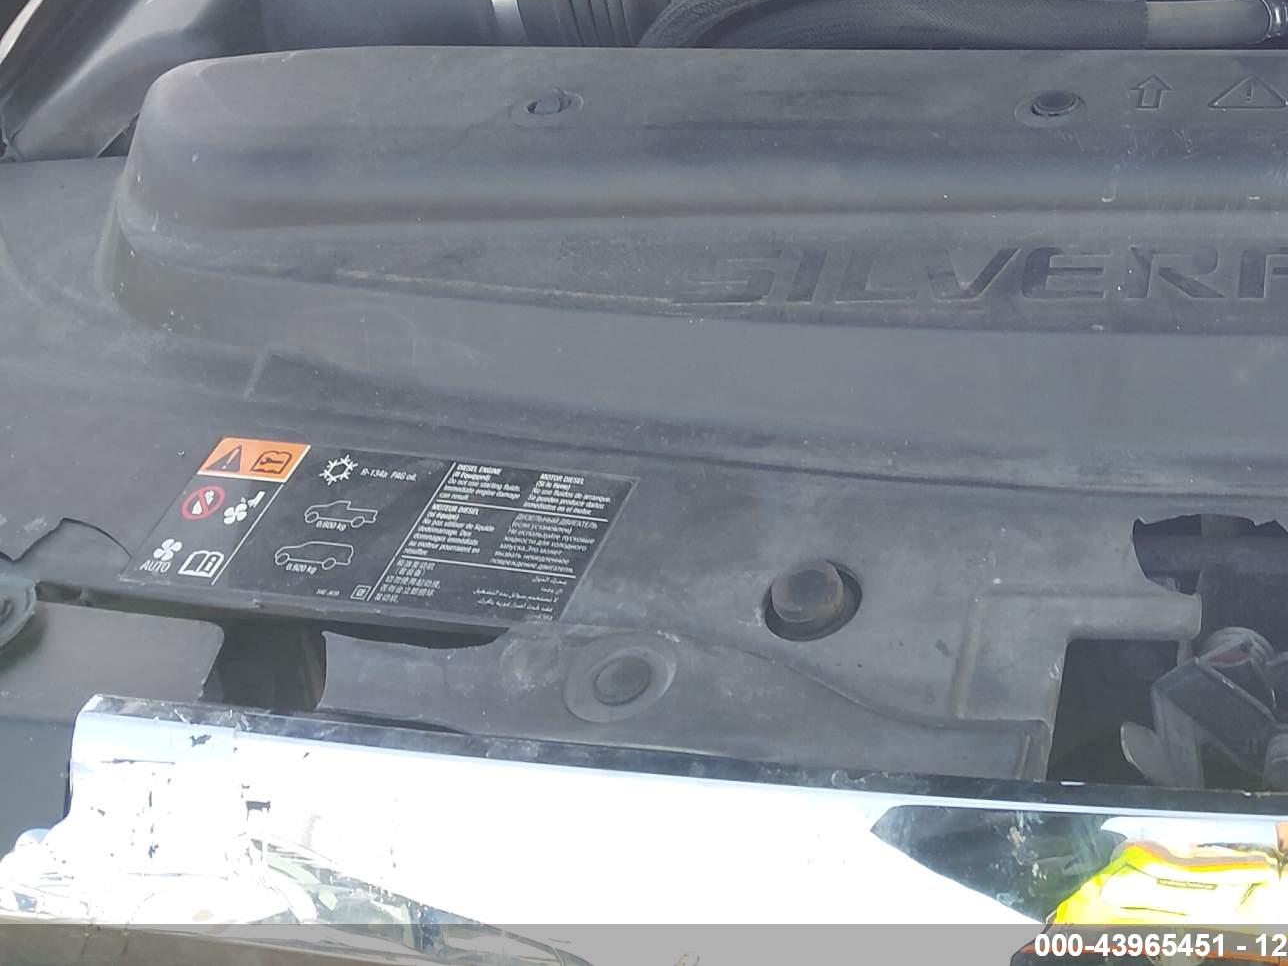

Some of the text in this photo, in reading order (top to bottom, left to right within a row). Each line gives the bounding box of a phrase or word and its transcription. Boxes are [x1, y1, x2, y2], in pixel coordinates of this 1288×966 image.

[457, 464, 502, 475] DIESEL ENGINE
[562, 475, 584, 485] DIESEL
[457, 506, 480, 515] DIESEL
[139, 559, 172, 573] AUTO
